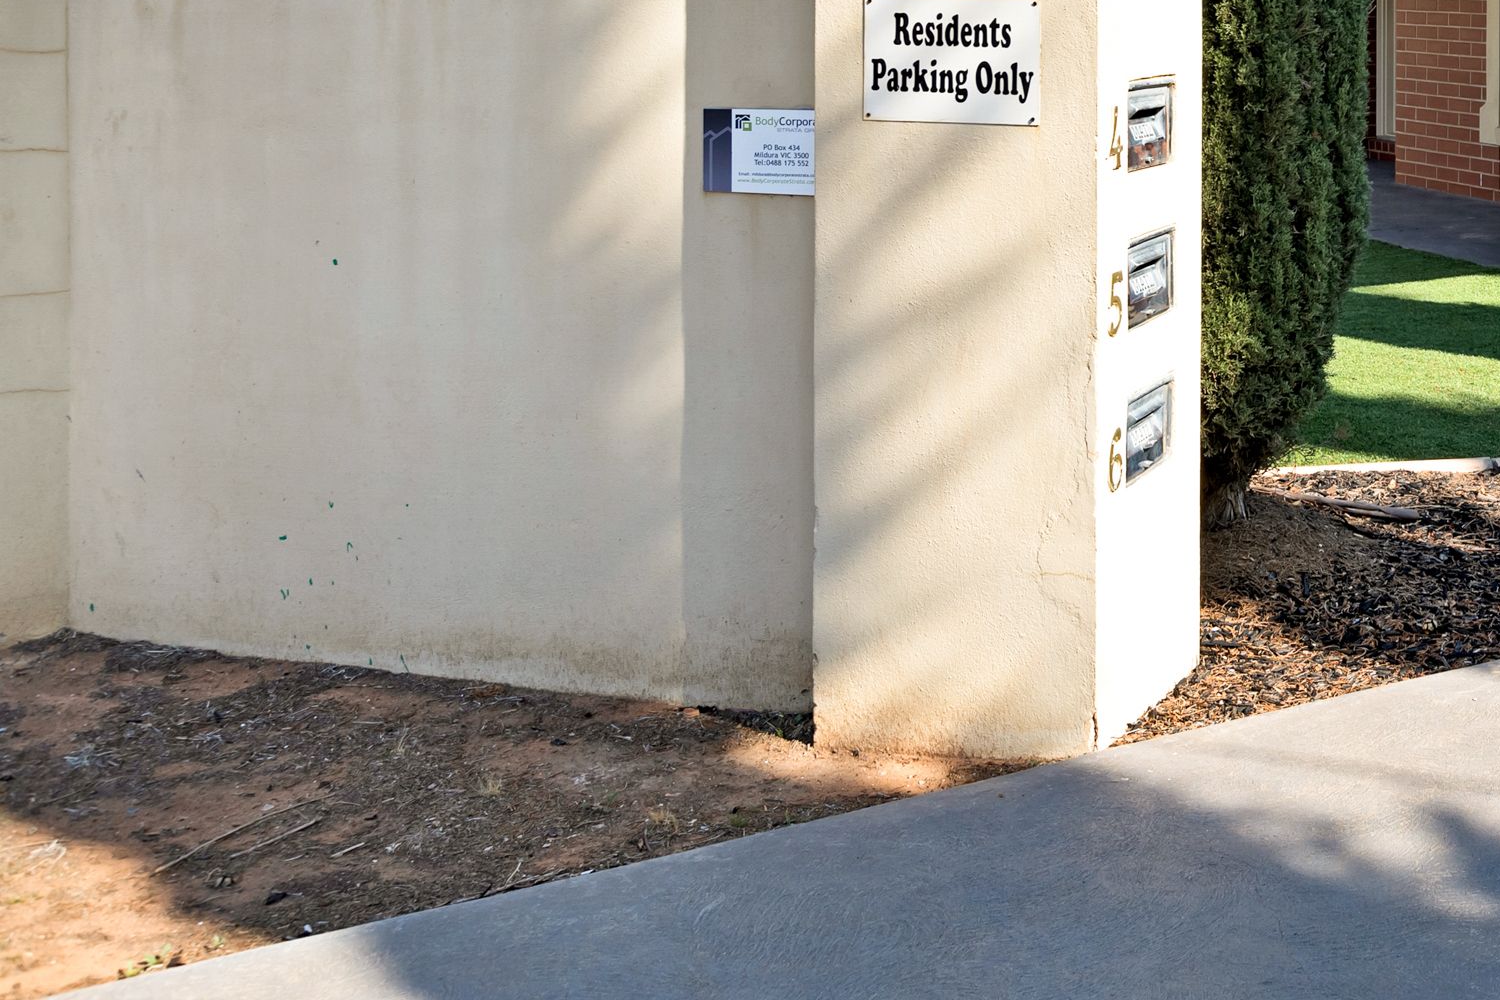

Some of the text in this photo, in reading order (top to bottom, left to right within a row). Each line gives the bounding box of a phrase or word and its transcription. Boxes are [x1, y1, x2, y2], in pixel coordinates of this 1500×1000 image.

[893, 12, 1012, 48] Residents
[871, 58, 1034, 103] Parking Only
[1108, 105, 1123, 170] 4
[1107, 270, 1123, 337] 5
[1107, 426, 1123, 493] 6
